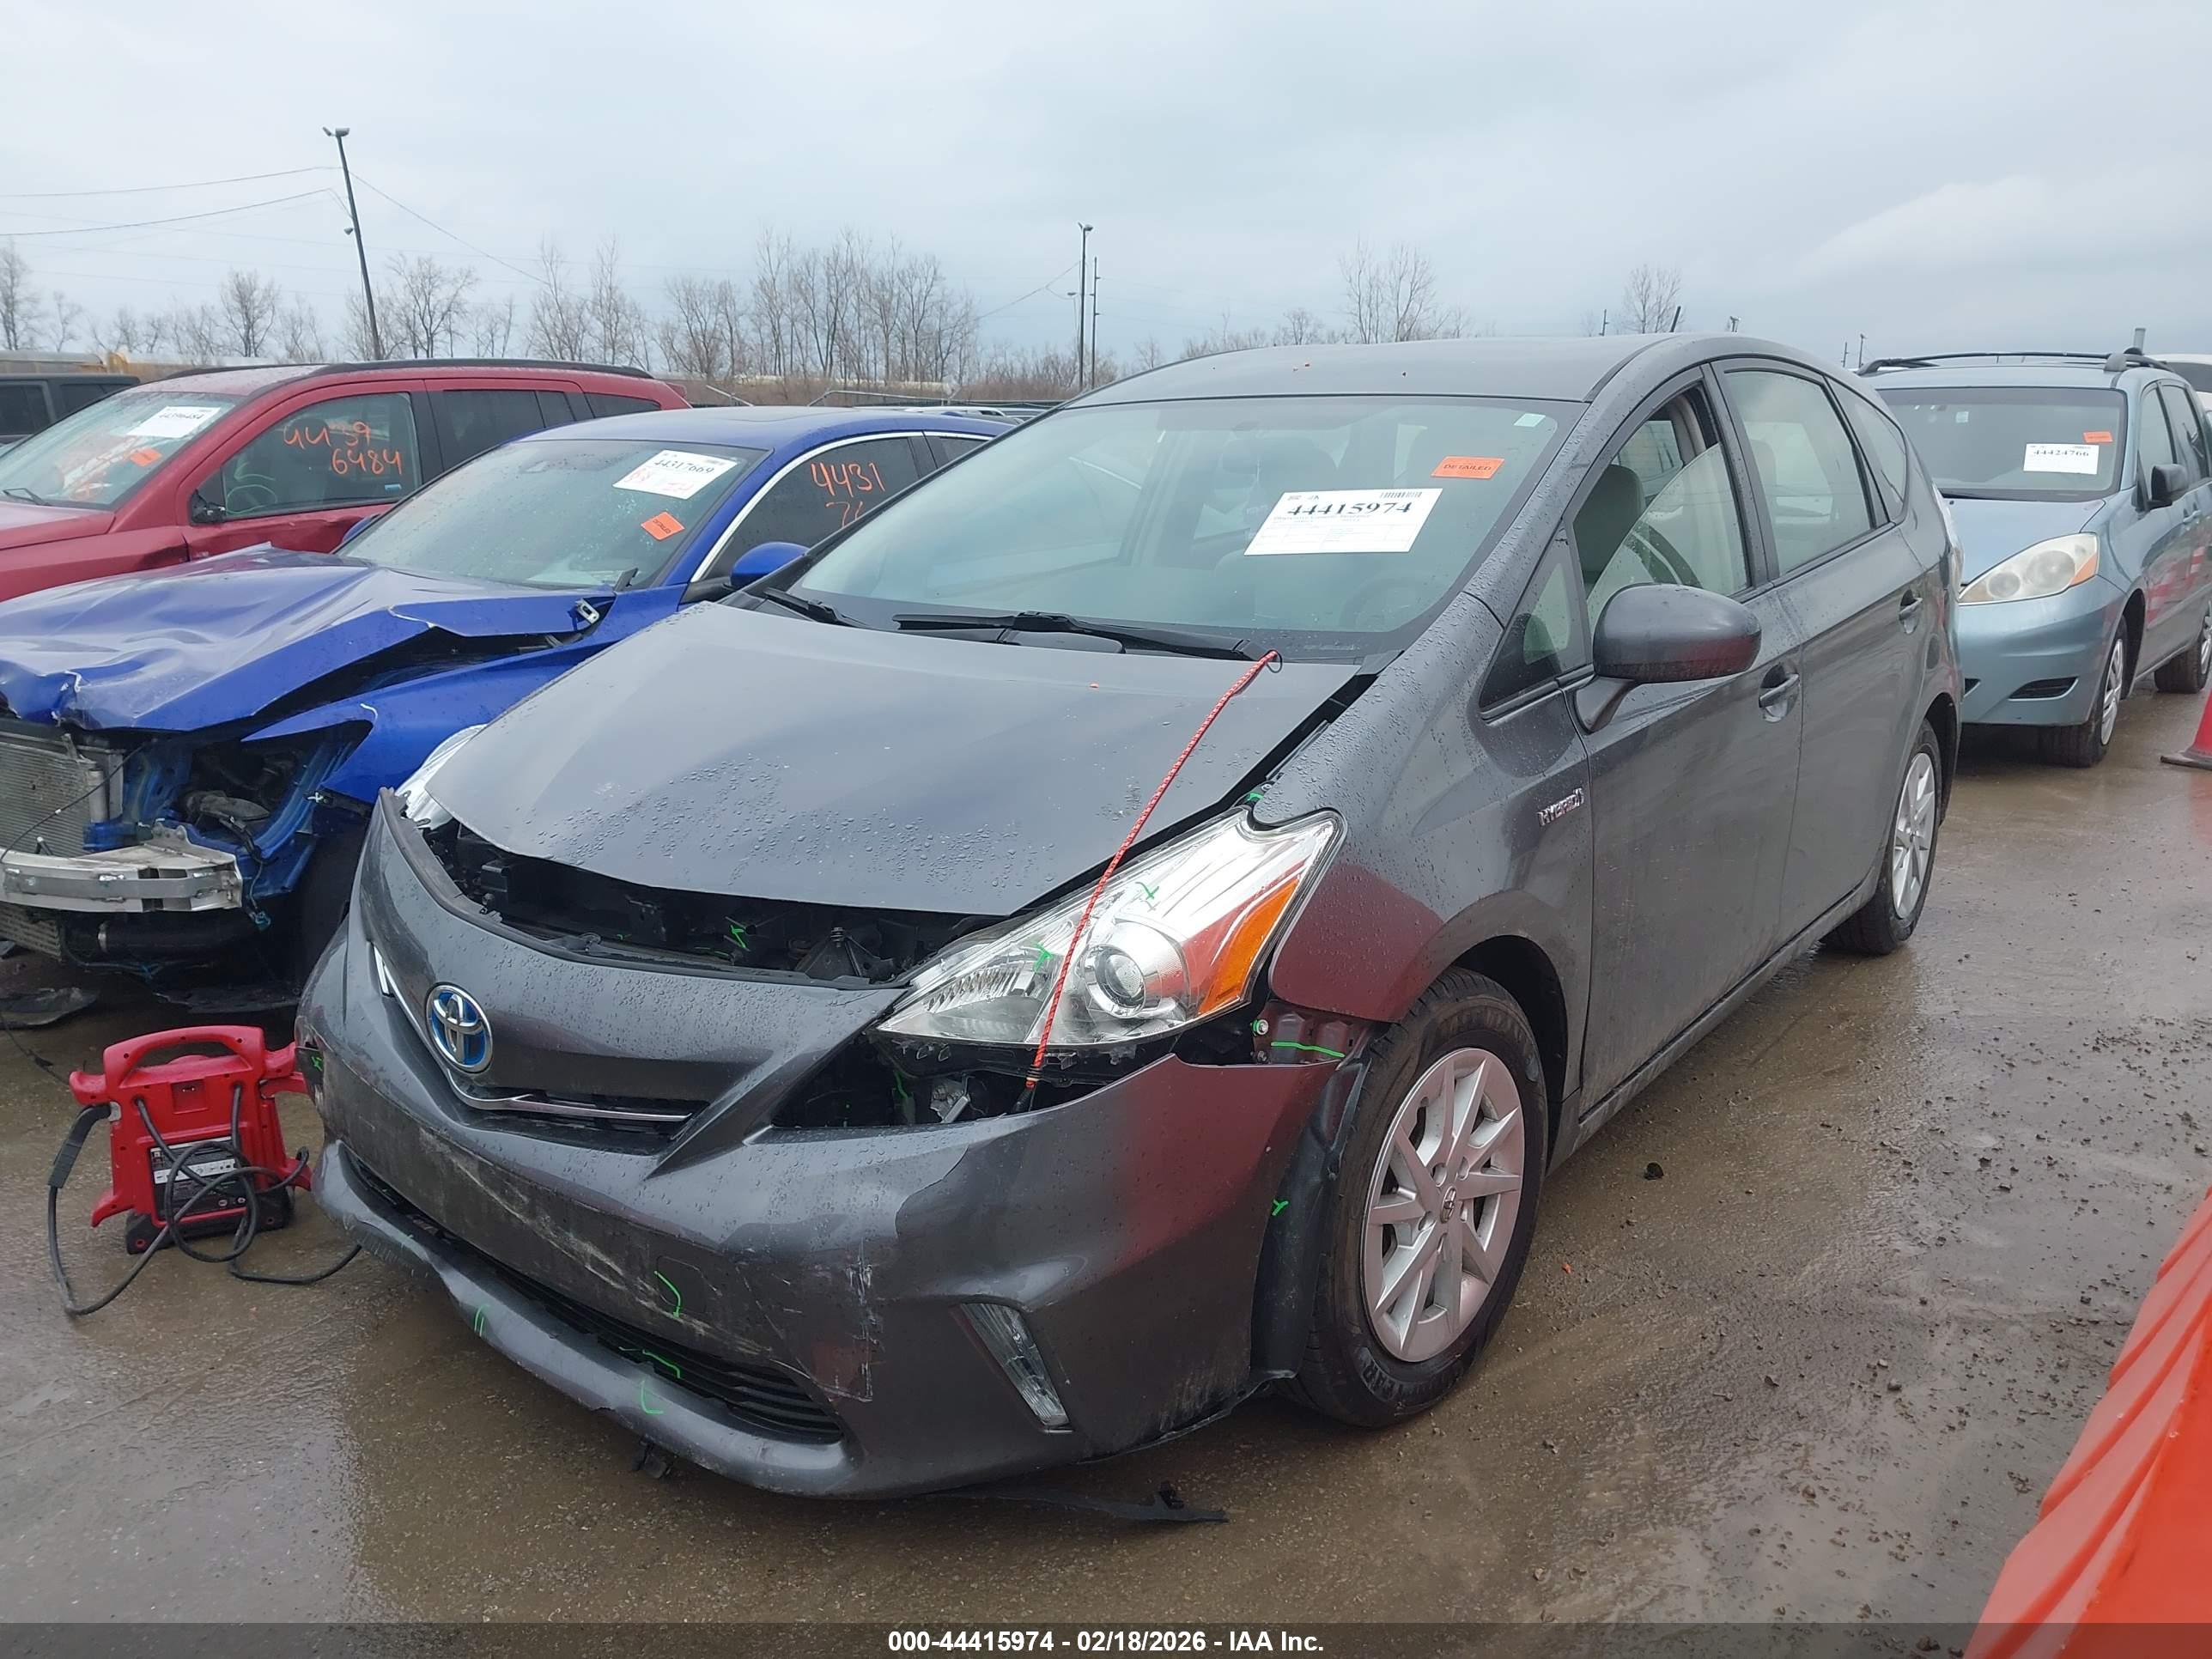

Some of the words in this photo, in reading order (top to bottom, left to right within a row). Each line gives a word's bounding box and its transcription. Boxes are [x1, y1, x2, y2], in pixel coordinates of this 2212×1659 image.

[332, 447, 403, 475] 6484
[810, 461, 886, 494] 4431
[1287, 501, 1413, 516] 44415974
